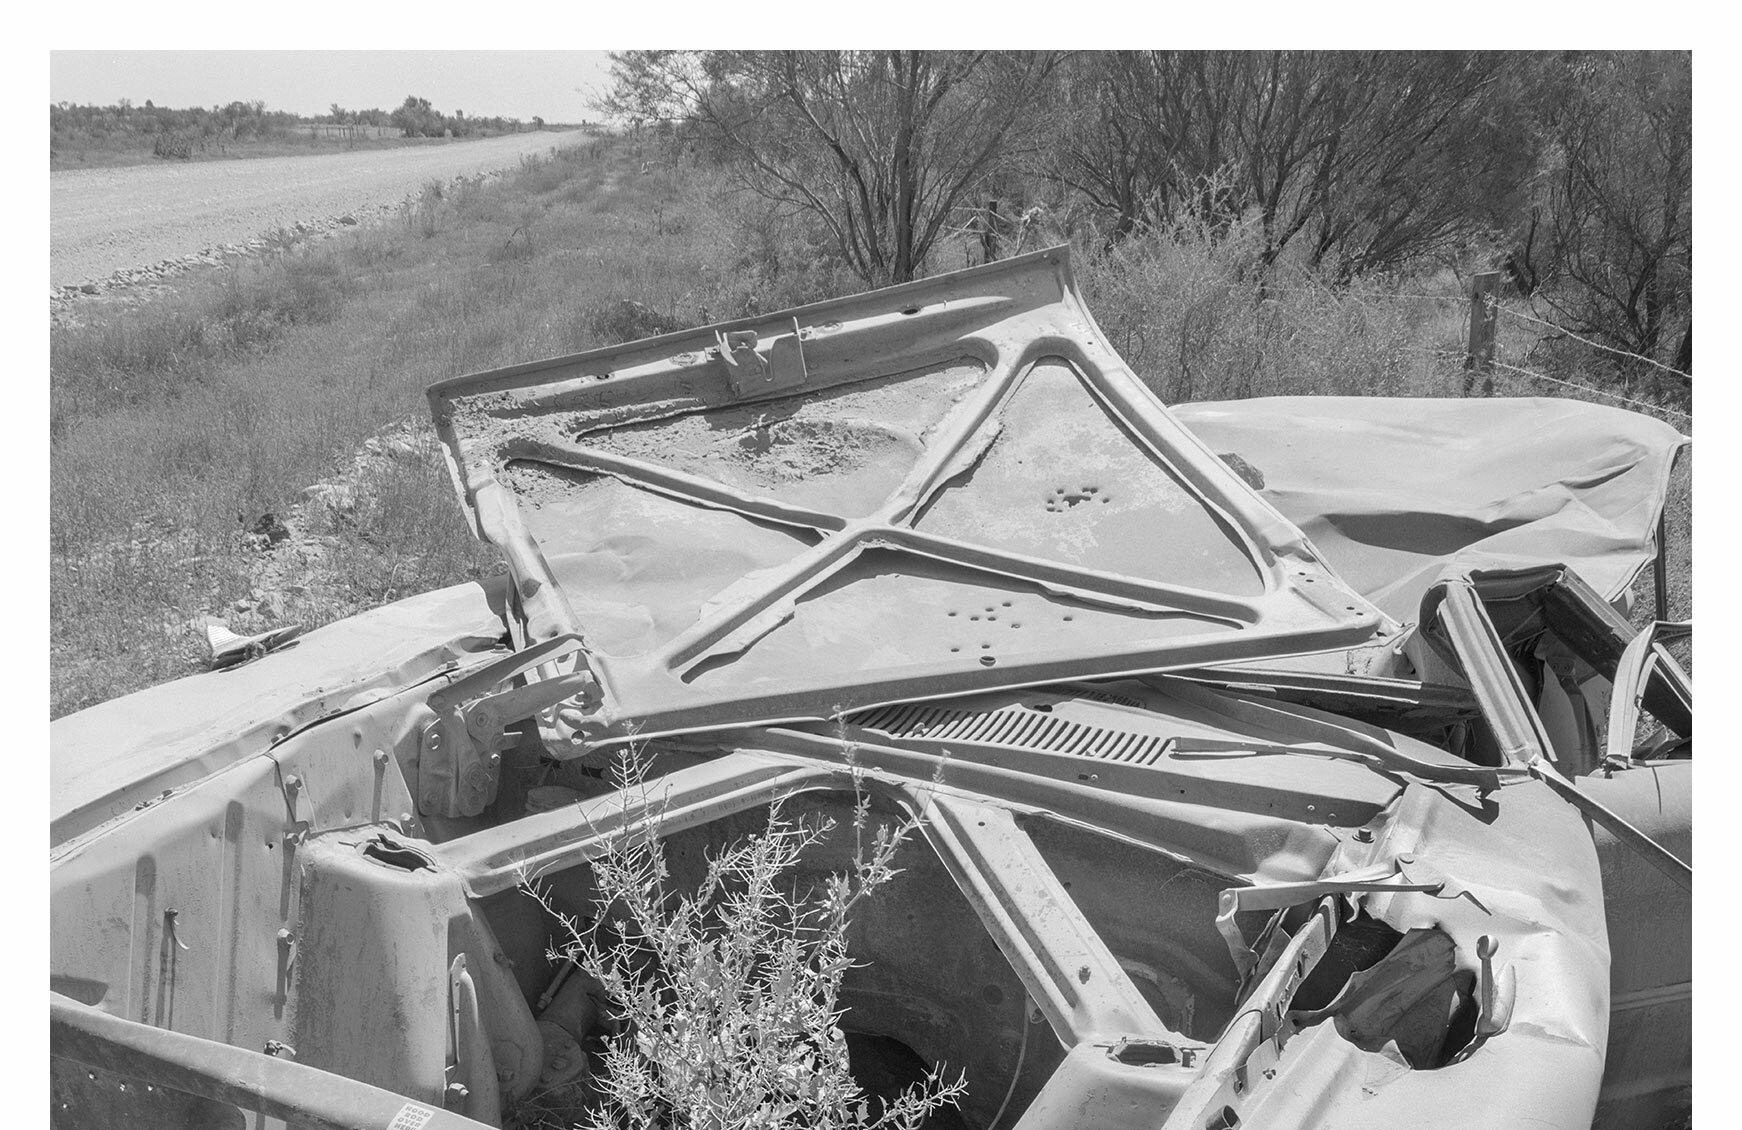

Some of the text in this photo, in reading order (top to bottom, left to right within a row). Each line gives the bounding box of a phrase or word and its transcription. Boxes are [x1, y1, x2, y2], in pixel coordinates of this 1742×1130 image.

[404, 1112, 423, 1121] ROD
[405, 1106, 430, 1117] HOOD
[398, 1117, 421, 1127] OVER
